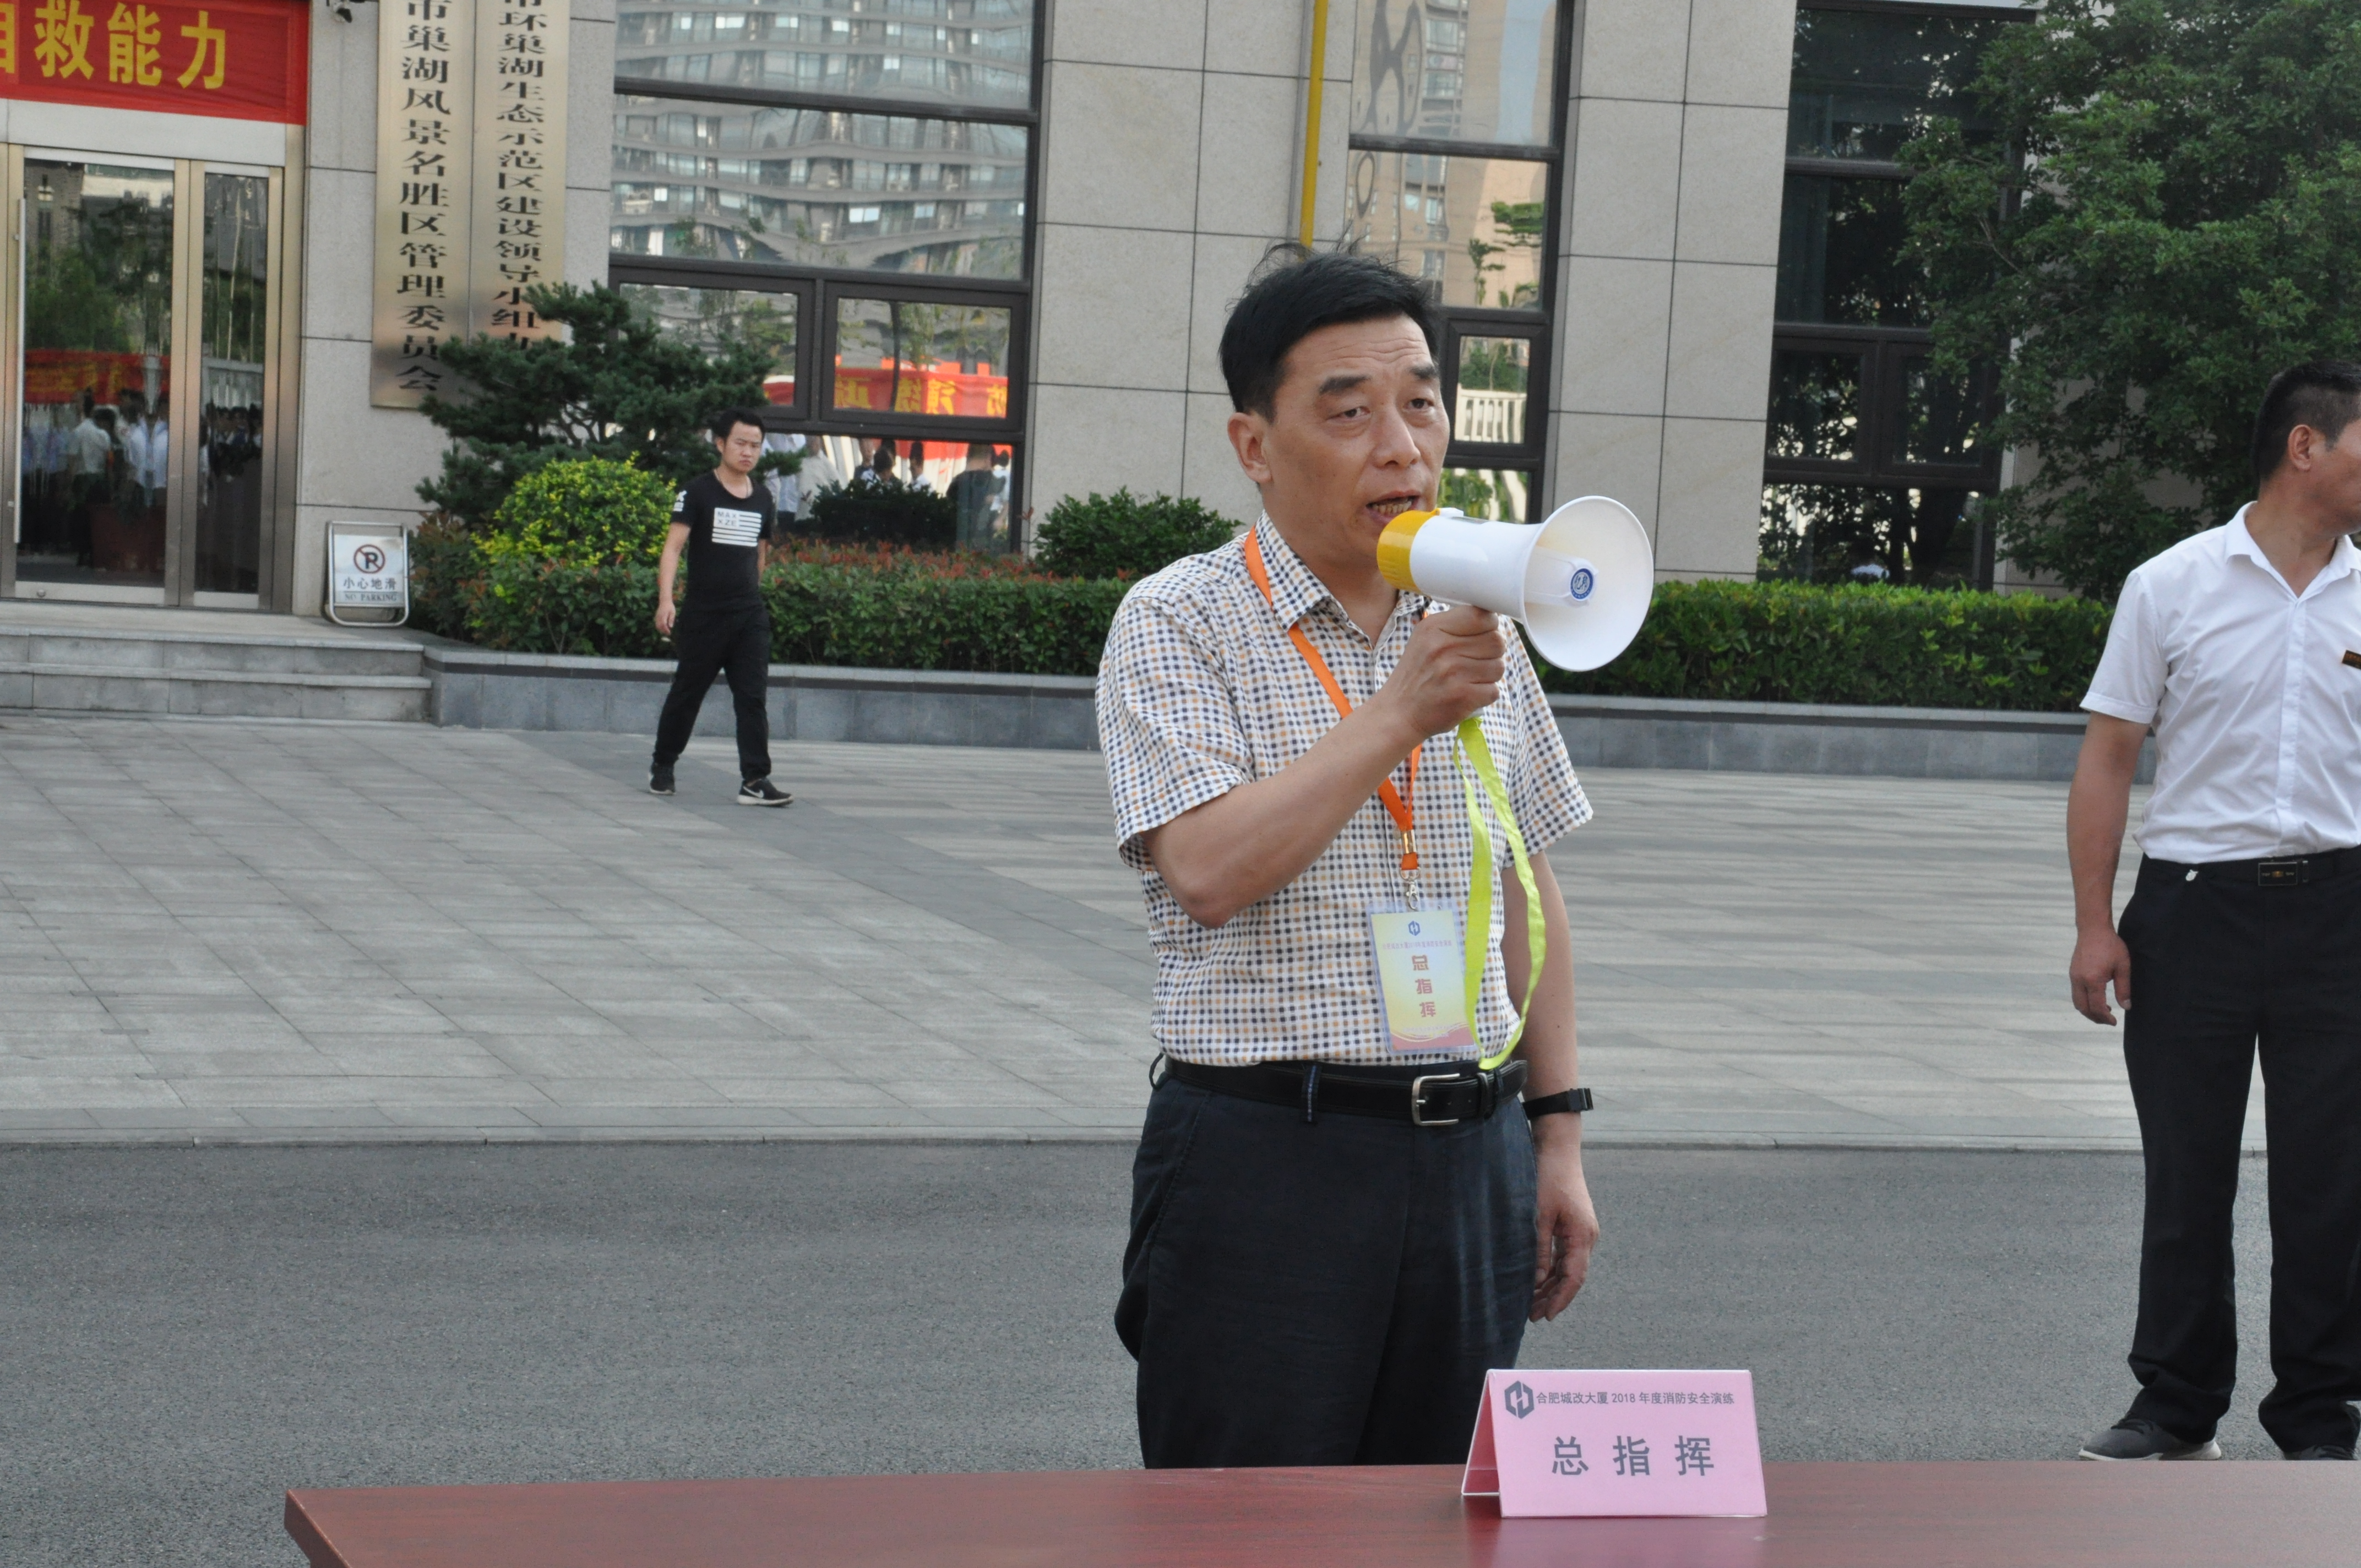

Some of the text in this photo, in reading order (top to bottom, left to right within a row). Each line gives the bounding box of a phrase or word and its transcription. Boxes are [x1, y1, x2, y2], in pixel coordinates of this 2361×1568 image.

[343, 576, 396, 590] 小心地滑
[361, 594, 397, 602] PARKING
[1411, 955, 1437, 1017] 总指挥
[1551, 1435, 1715, 1477] 总指挥
